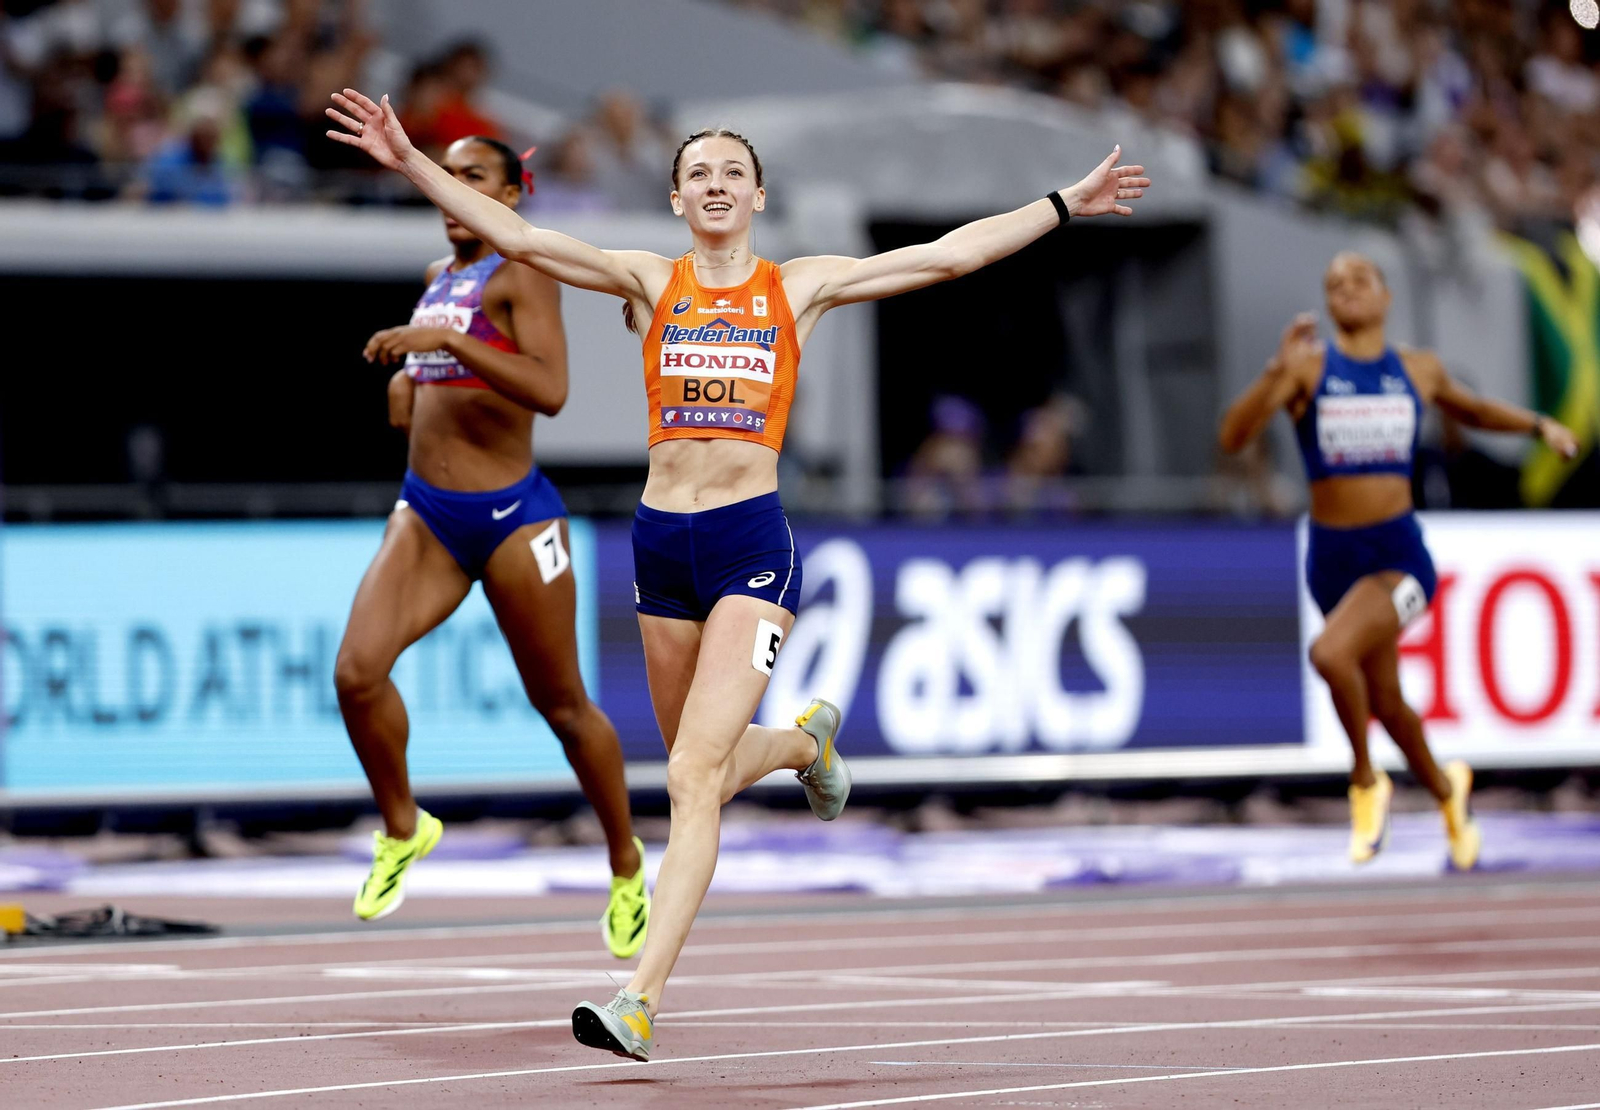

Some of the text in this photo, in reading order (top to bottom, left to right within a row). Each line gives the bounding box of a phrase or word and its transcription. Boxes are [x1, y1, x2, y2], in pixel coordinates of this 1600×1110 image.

[662, 353, 771, 375] HONDA
[683, 378, 745, 404] BOL
[543, 536, 558, 569] 7
[765, 632, 781, 670] 5
[877, 556, 1147, 754] asics
